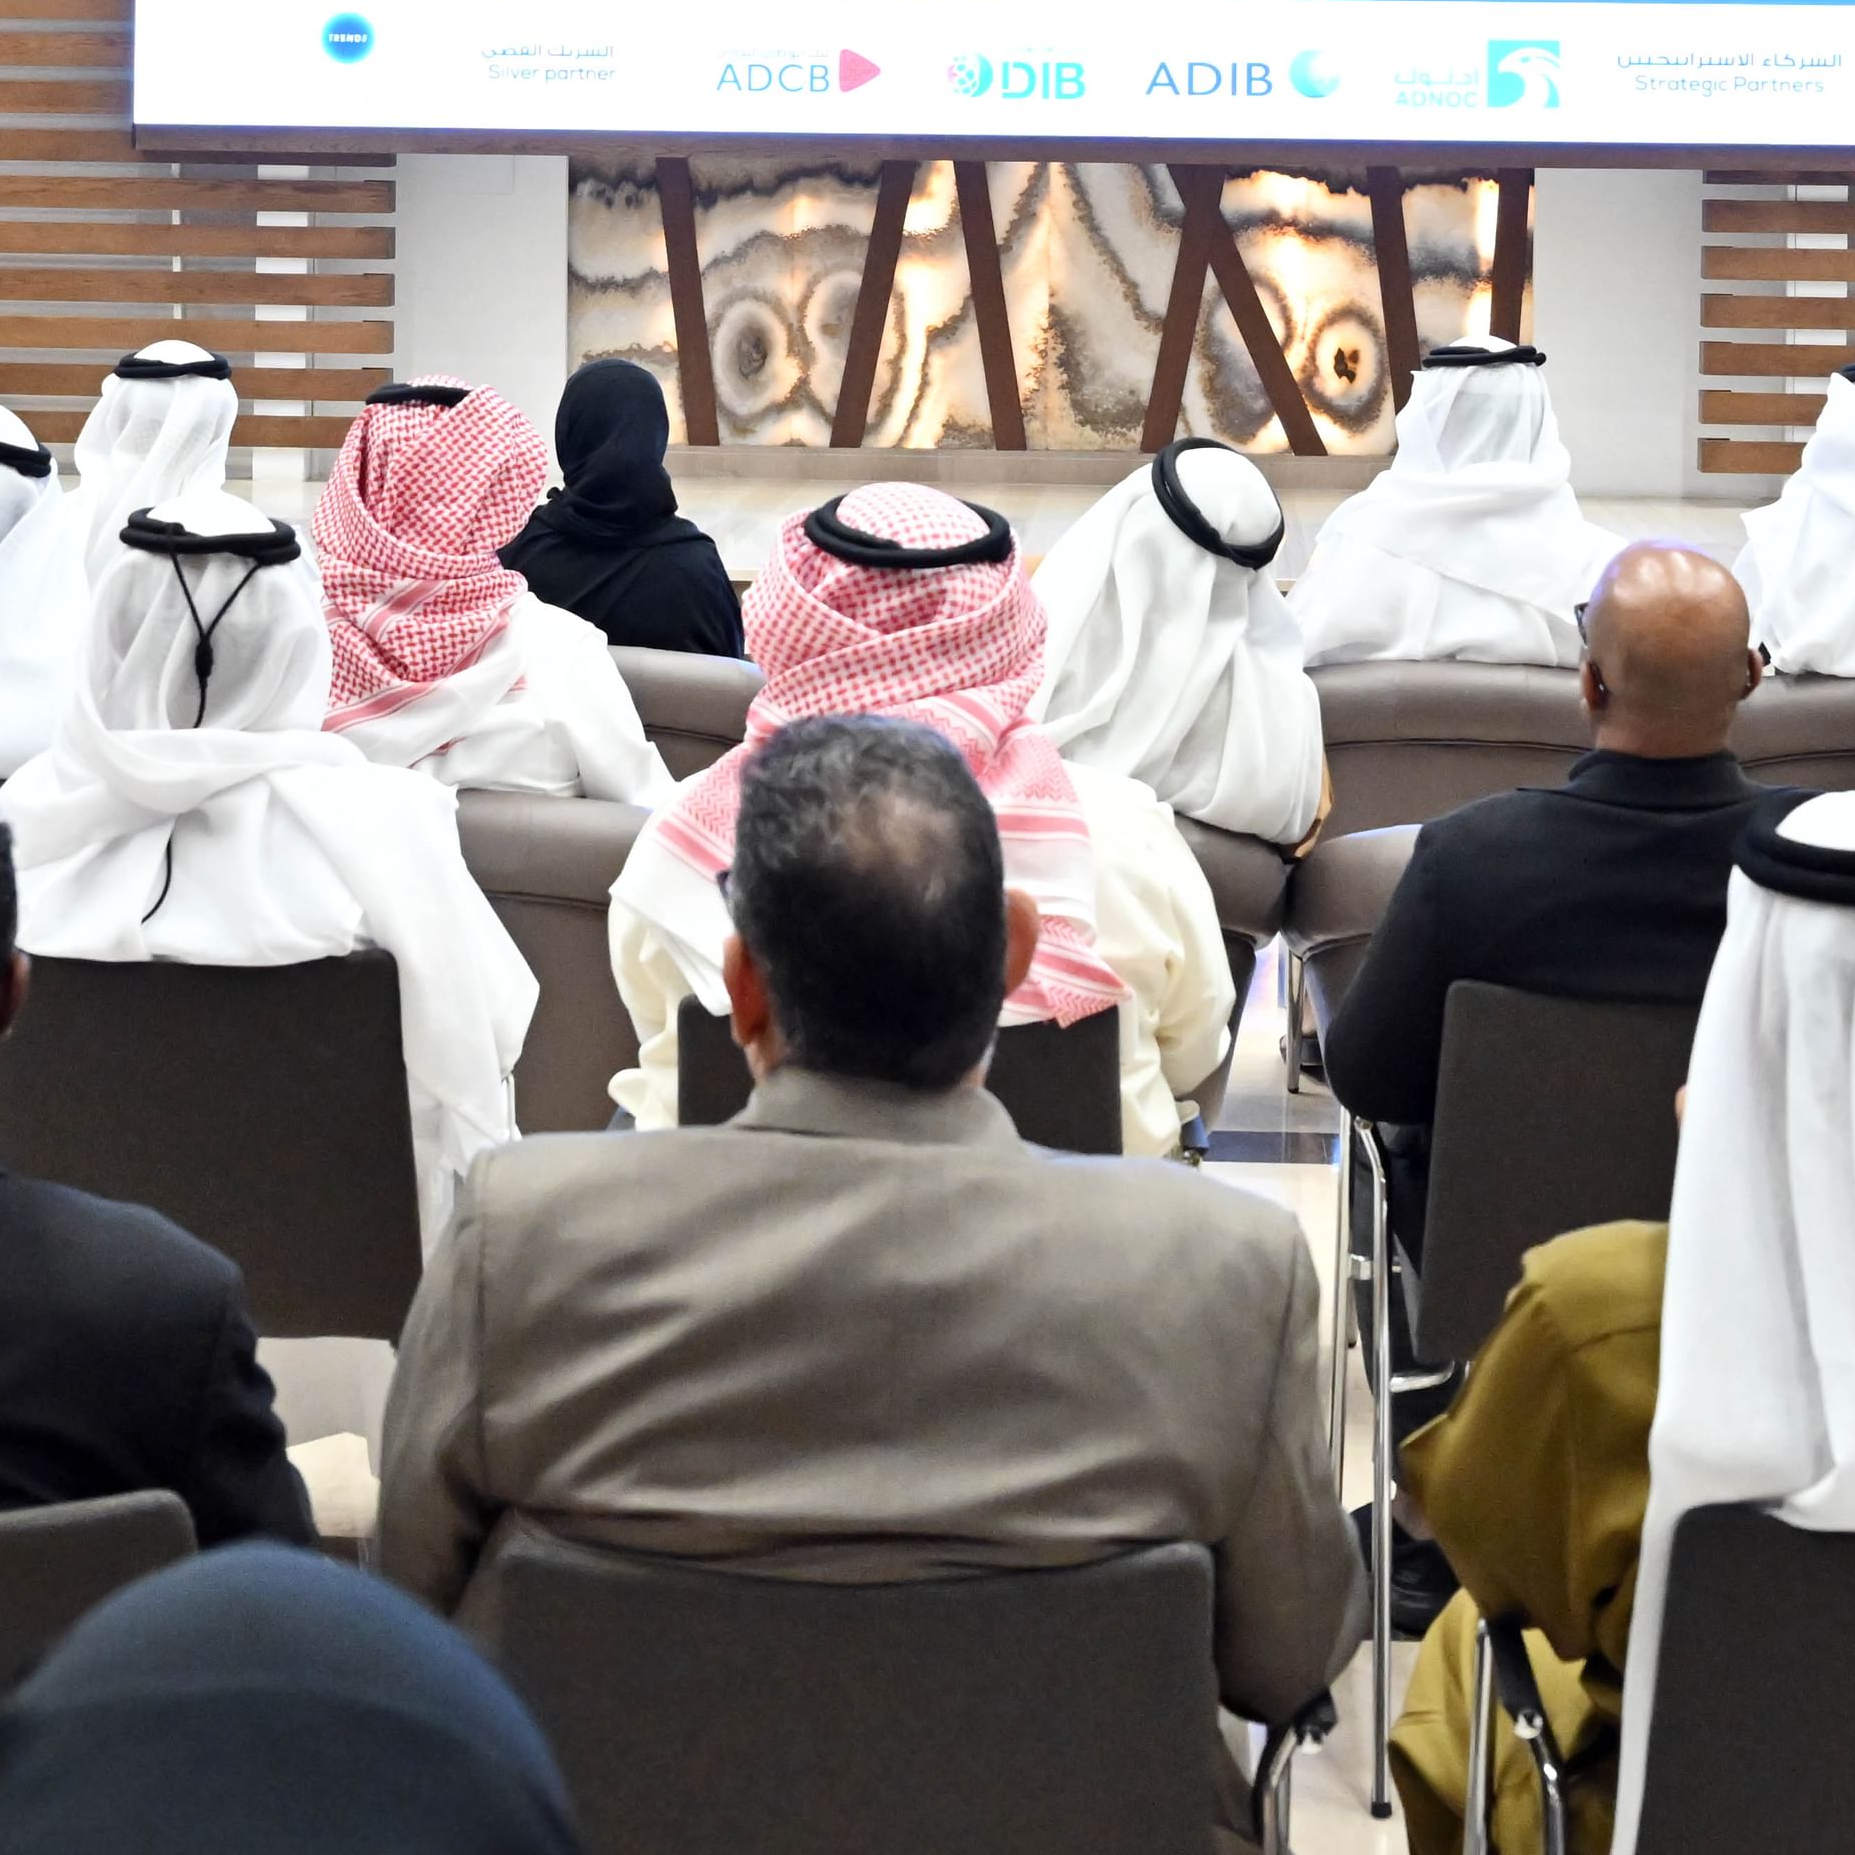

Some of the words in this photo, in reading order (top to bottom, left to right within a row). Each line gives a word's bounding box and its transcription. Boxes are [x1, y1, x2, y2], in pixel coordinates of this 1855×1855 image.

[328, 33, 368, 43] TRENDS
[488, 64, 539, 80] Silver
[545, 68, 616, 83] partner
[716, 64, 830, 92] ADCB
[1002, 61, 1086, 100] DIB
[1145, 61, 1273, 97] ADIB
[1635, 75, 1728, 97] Strategic
[1734, 76, 1825, 93] Partners
[1395, 90, 1478, 108] ADNOC
